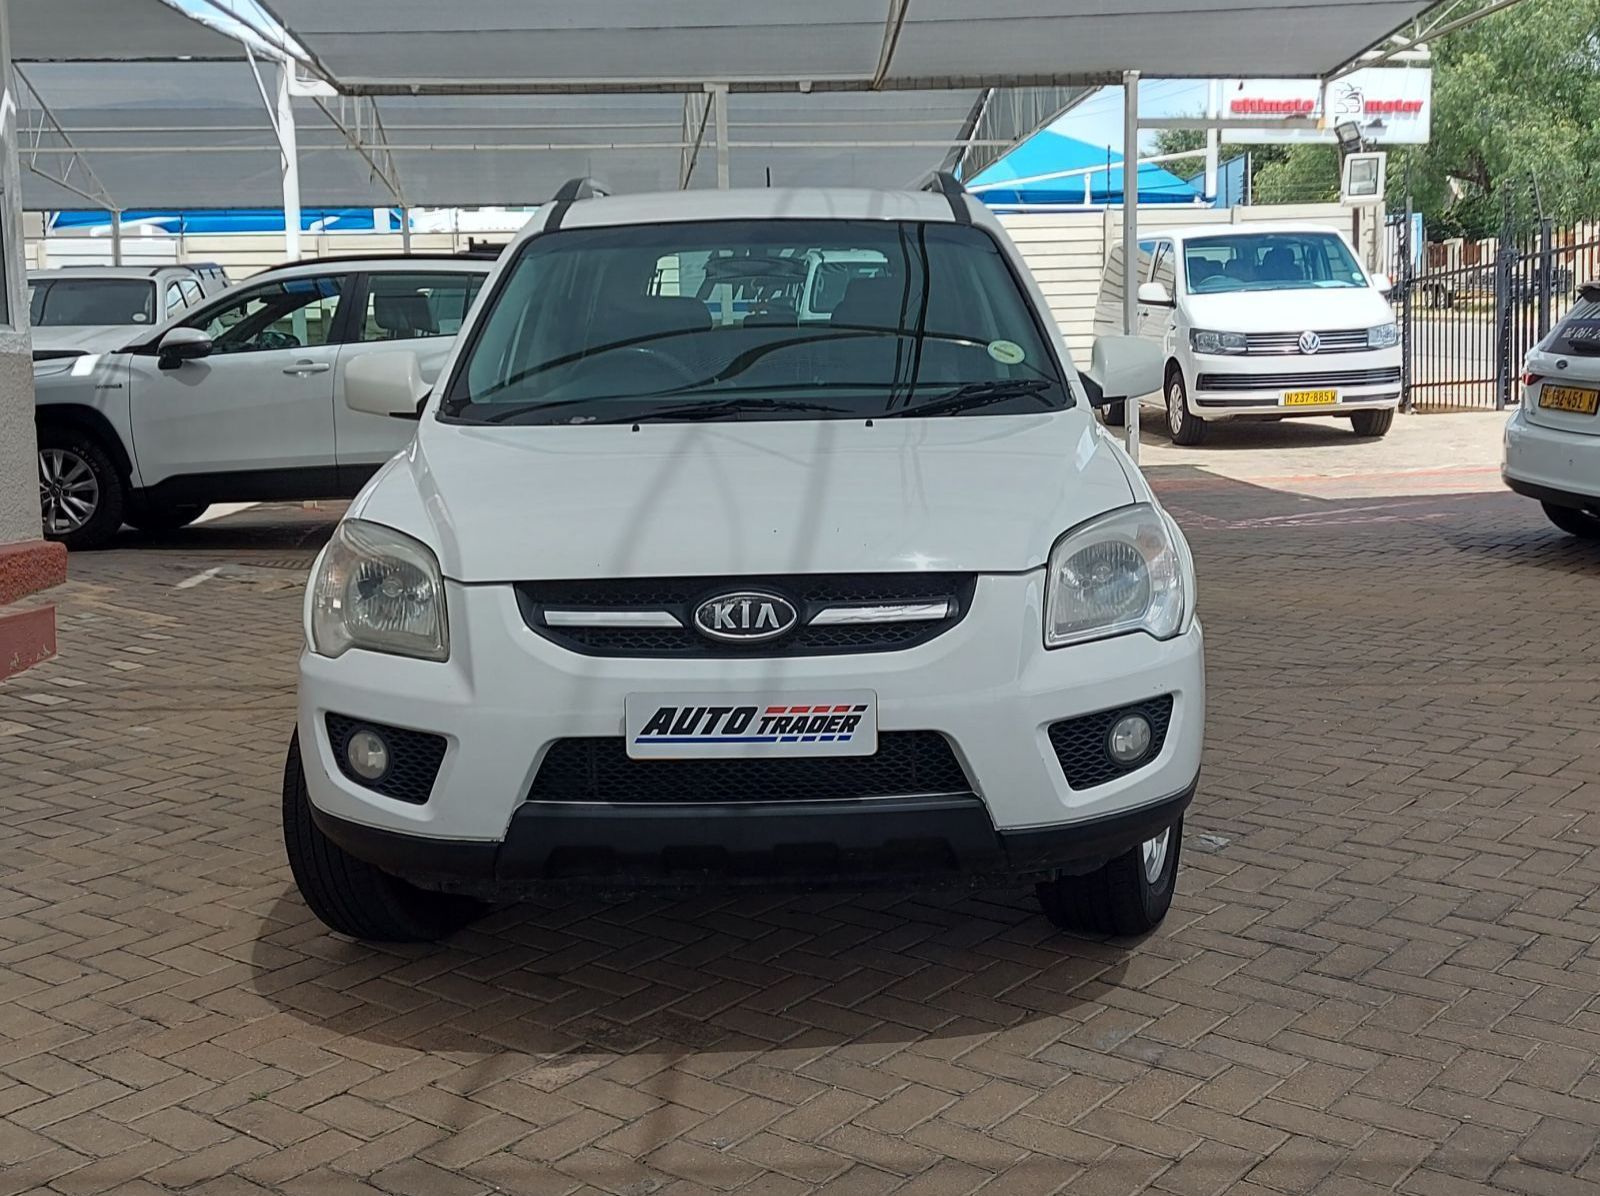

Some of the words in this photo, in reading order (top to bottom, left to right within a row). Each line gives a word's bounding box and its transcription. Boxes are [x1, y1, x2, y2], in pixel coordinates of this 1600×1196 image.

[713, 602, 780, 629] KIA
[641, 706, 758, 735] AUTO
[757, 714, 861, 735] TRADER
